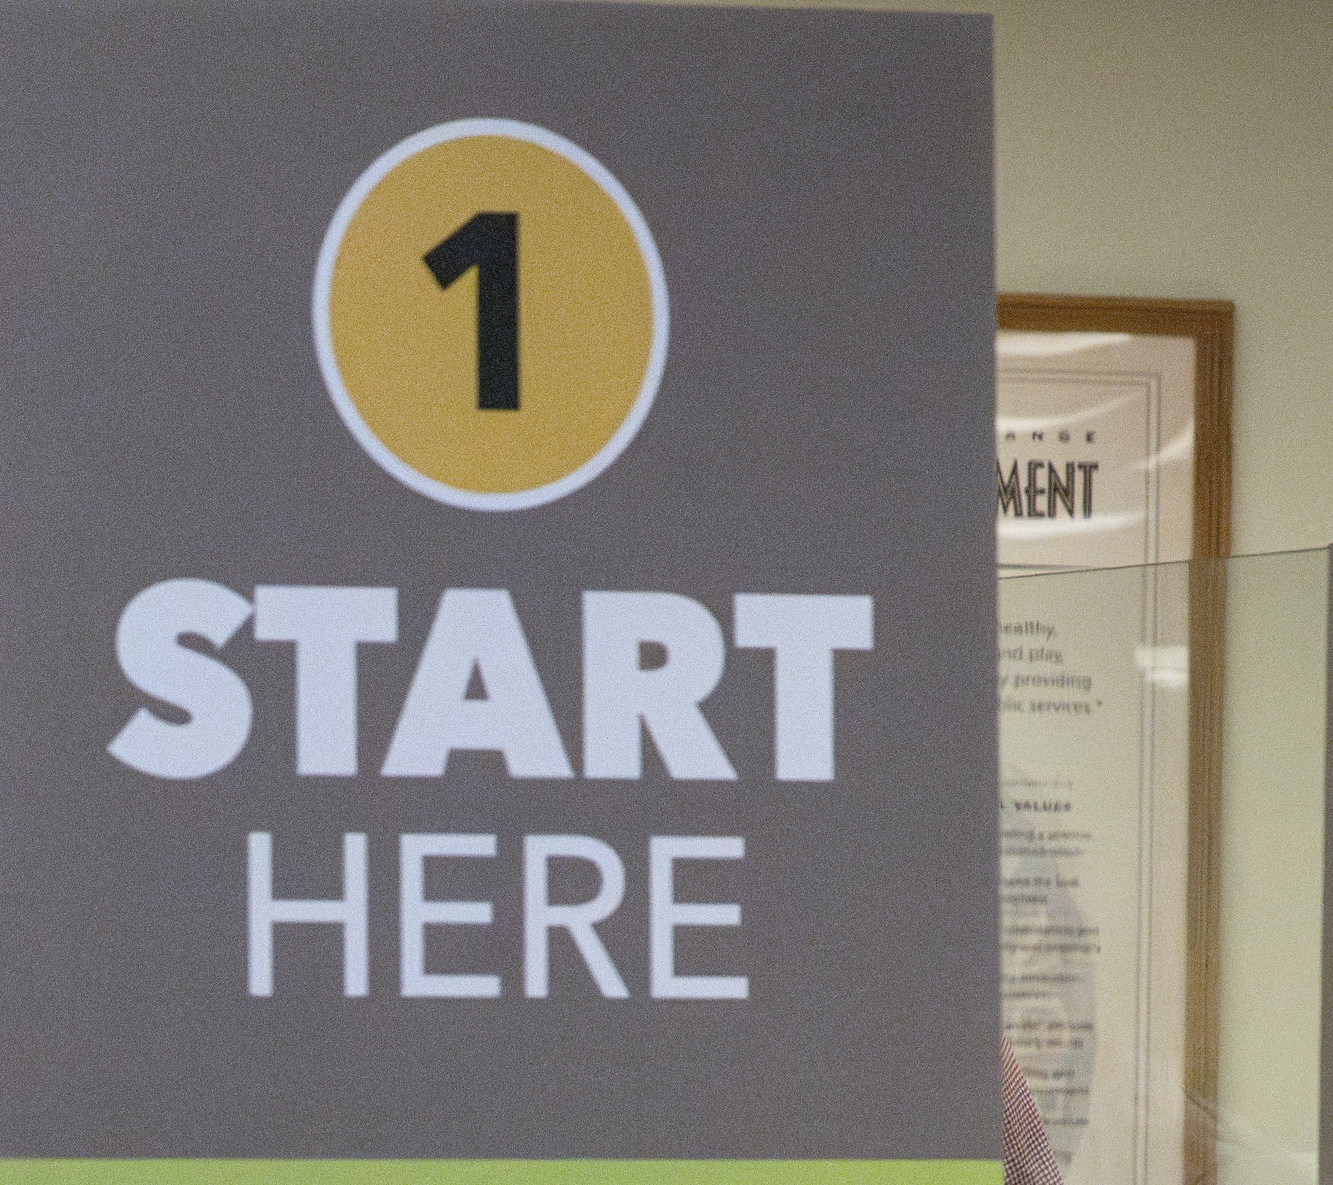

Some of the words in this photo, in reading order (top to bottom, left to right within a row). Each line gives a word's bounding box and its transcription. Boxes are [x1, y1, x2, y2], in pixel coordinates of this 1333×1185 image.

[421, 211, 520, 411] 1
[106, 578, 874, 781] START
[247, 832, 749, 999] HERE
